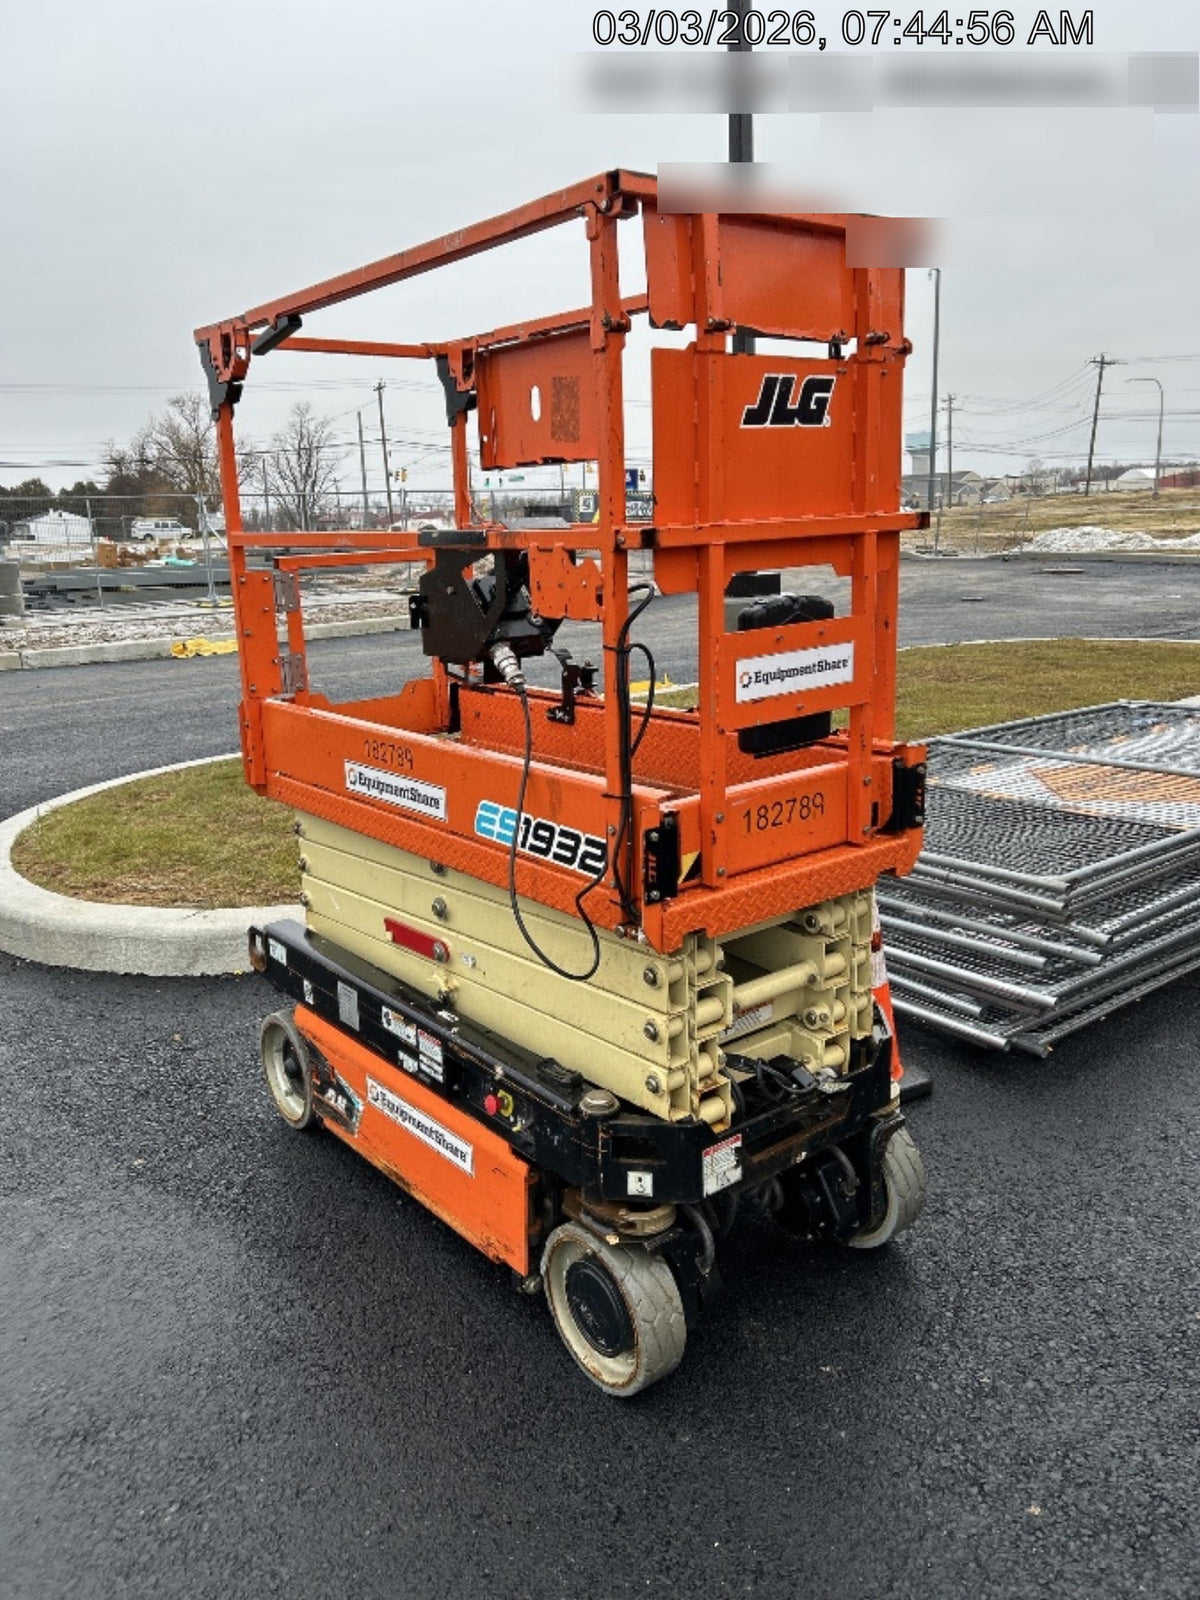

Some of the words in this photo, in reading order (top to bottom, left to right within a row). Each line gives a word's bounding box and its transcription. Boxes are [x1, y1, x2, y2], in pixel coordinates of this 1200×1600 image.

[740, 373, 836, 428] JLG
[754, 657, 849, 685] EquipmentShare
[364, 740, 414, 770] 182789
[743, 792, 824, 833] 182789
[475, 800, 607, 880] ES1932
